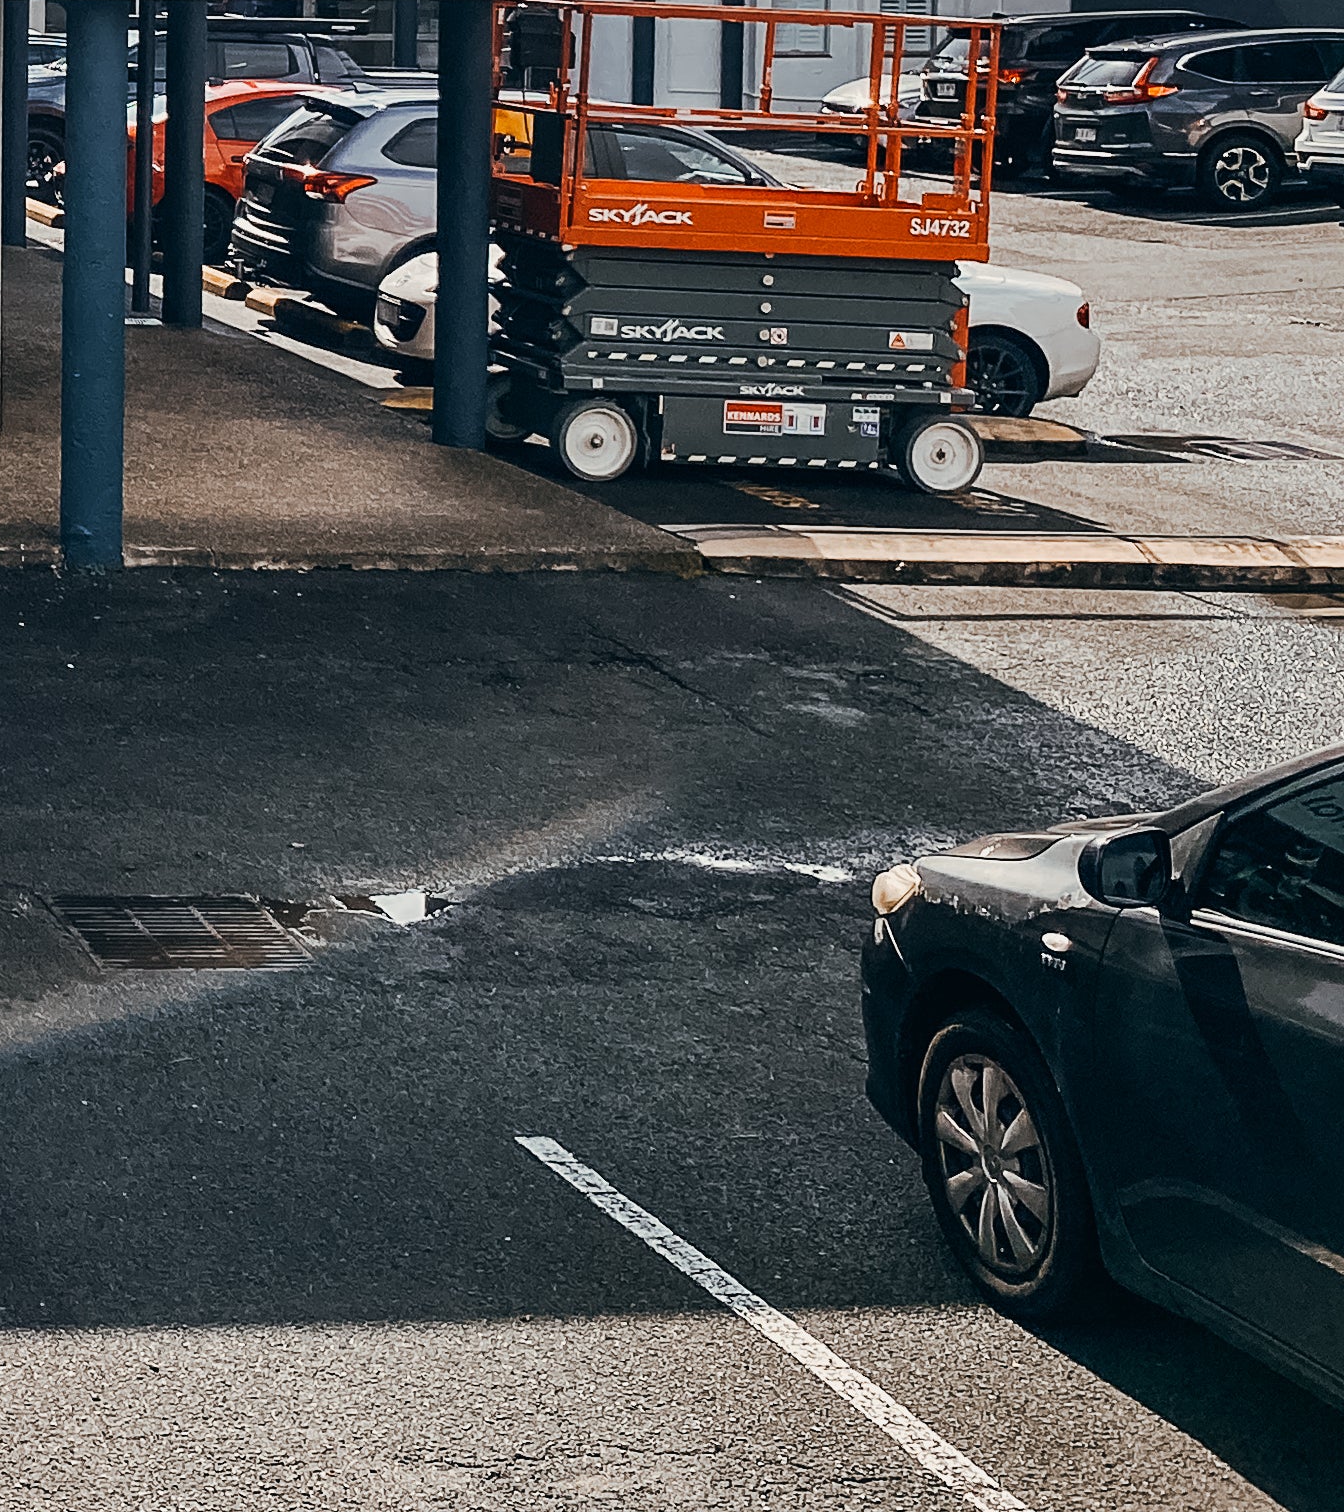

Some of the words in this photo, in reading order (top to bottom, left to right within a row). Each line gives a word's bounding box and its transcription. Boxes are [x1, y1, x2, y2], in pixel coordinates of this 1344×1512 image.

[588, 203, 694, 226] SKYJACK
[909, 218, 971, 238] SJ4732
[620, 318, 725, 342] SKYJACK
[739, 382, 806, 397] SKYJACK
[727, 410, 782, 423] KENNARDS
